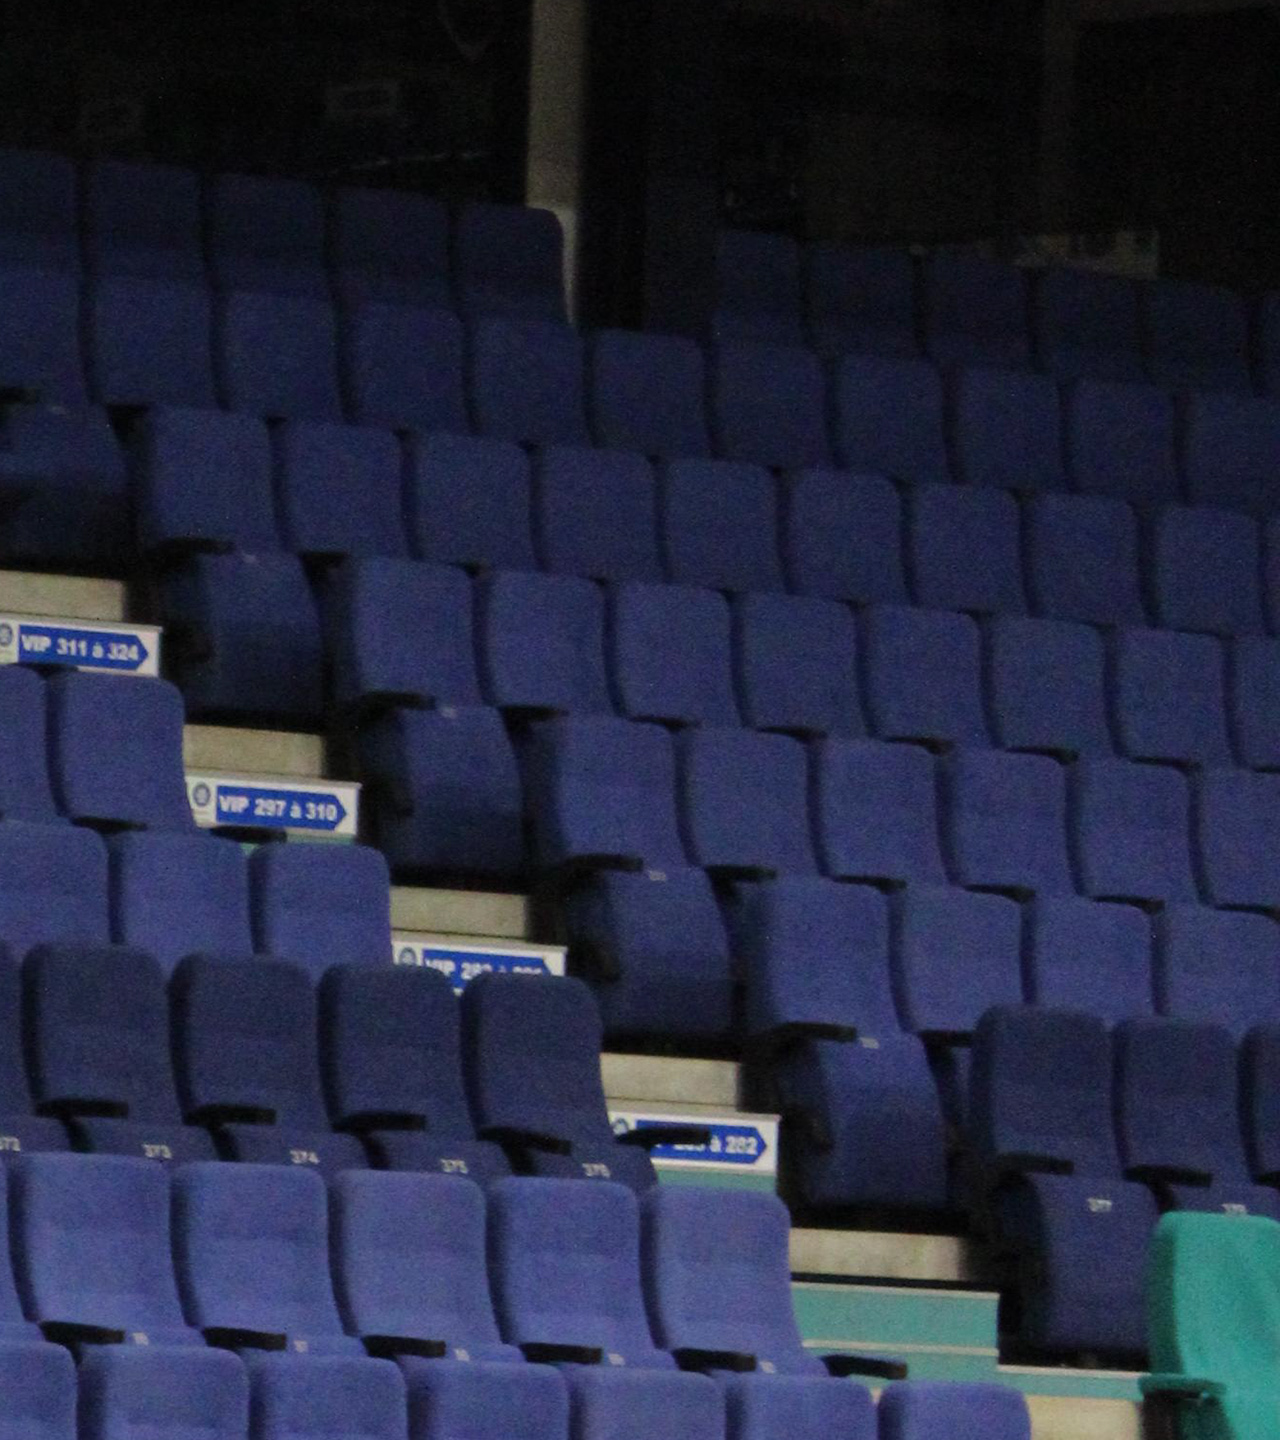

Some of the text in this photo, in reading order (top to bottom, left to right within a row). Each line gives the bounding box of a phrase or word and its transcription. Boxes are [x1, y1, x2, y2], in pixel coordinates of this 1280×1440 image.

[21, 634, 139, 661] VIP 311 à 324
[218, 793, 338, 821] VIP 297 à 310
